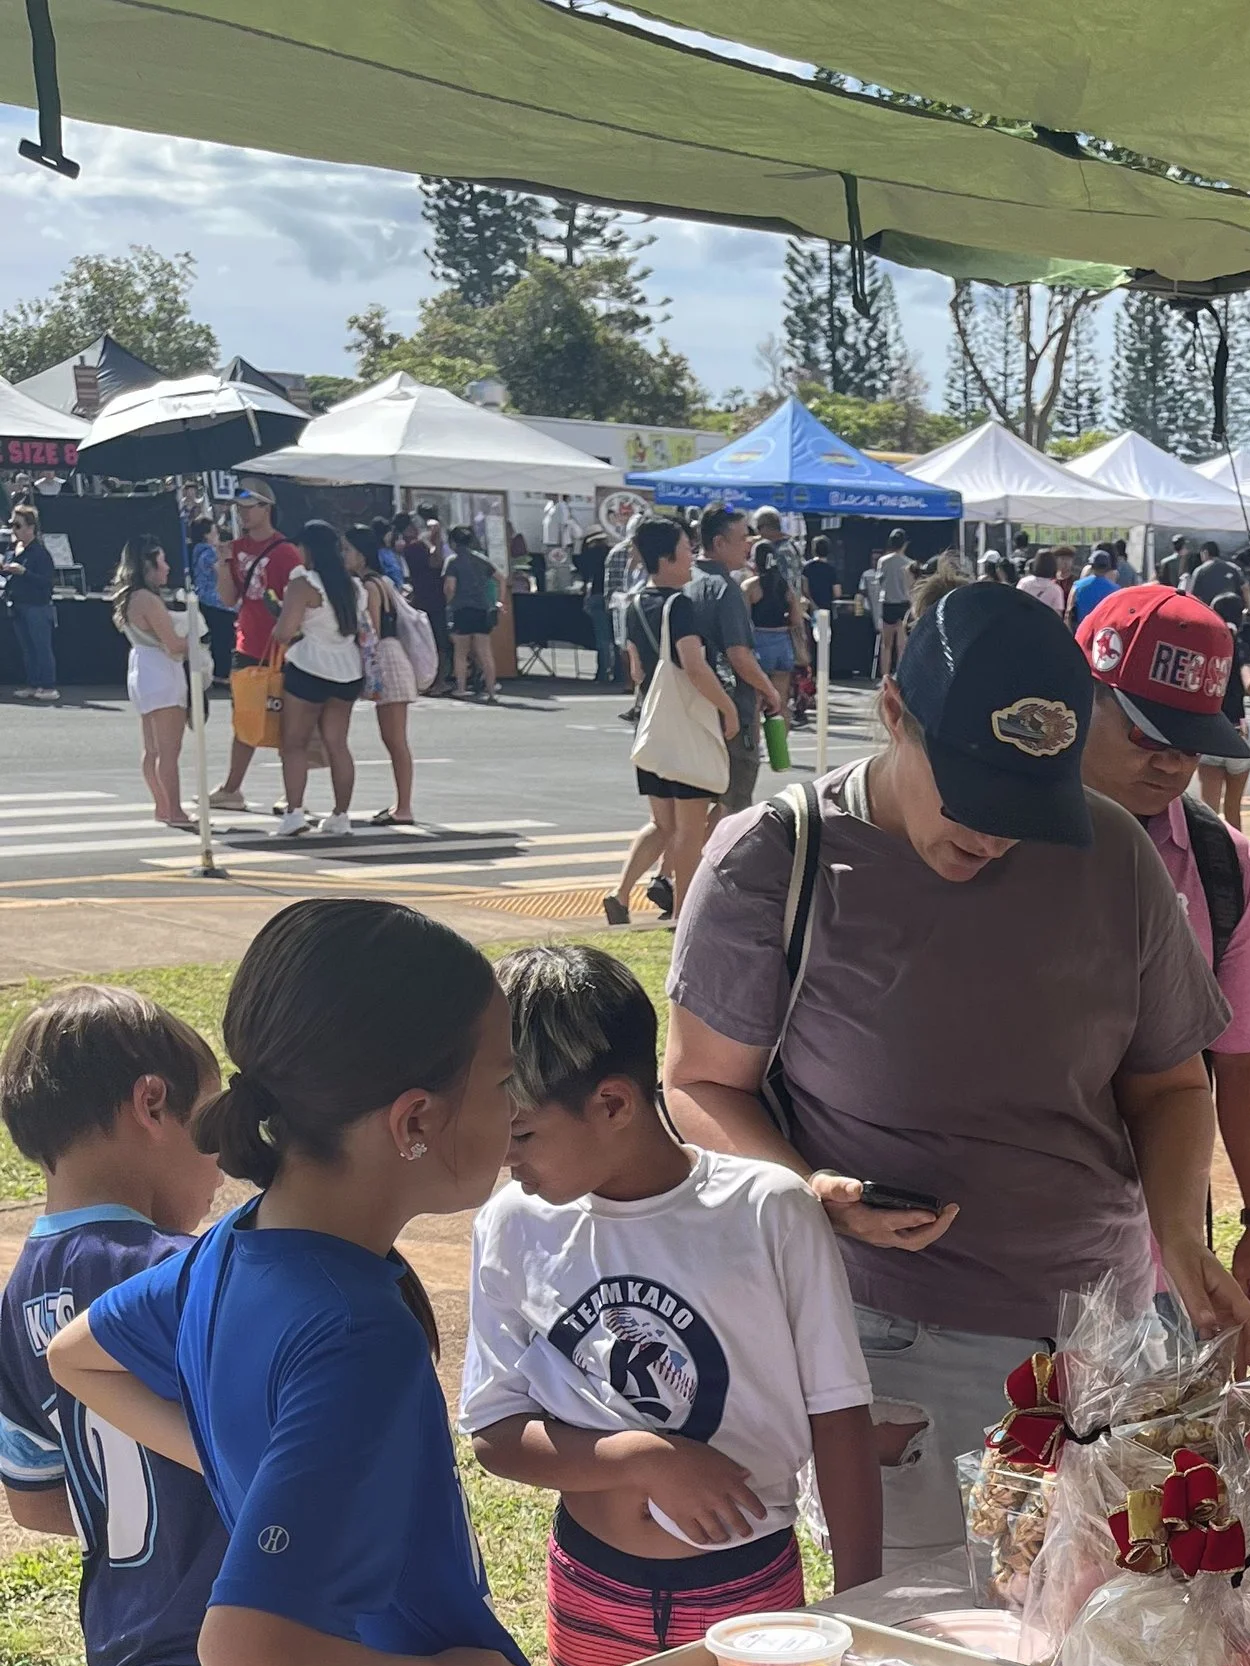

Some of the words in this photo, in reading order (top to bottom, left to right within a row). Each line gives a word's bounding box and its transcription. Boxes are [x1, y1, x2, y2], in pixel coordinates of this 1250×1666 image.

[8, 440, 58, 465] SIZE
[1151, 641, 1206, 692] RED
[563, 1281, 623, 1333] TEAM
[627, 1281, 694, 1331] KADO
